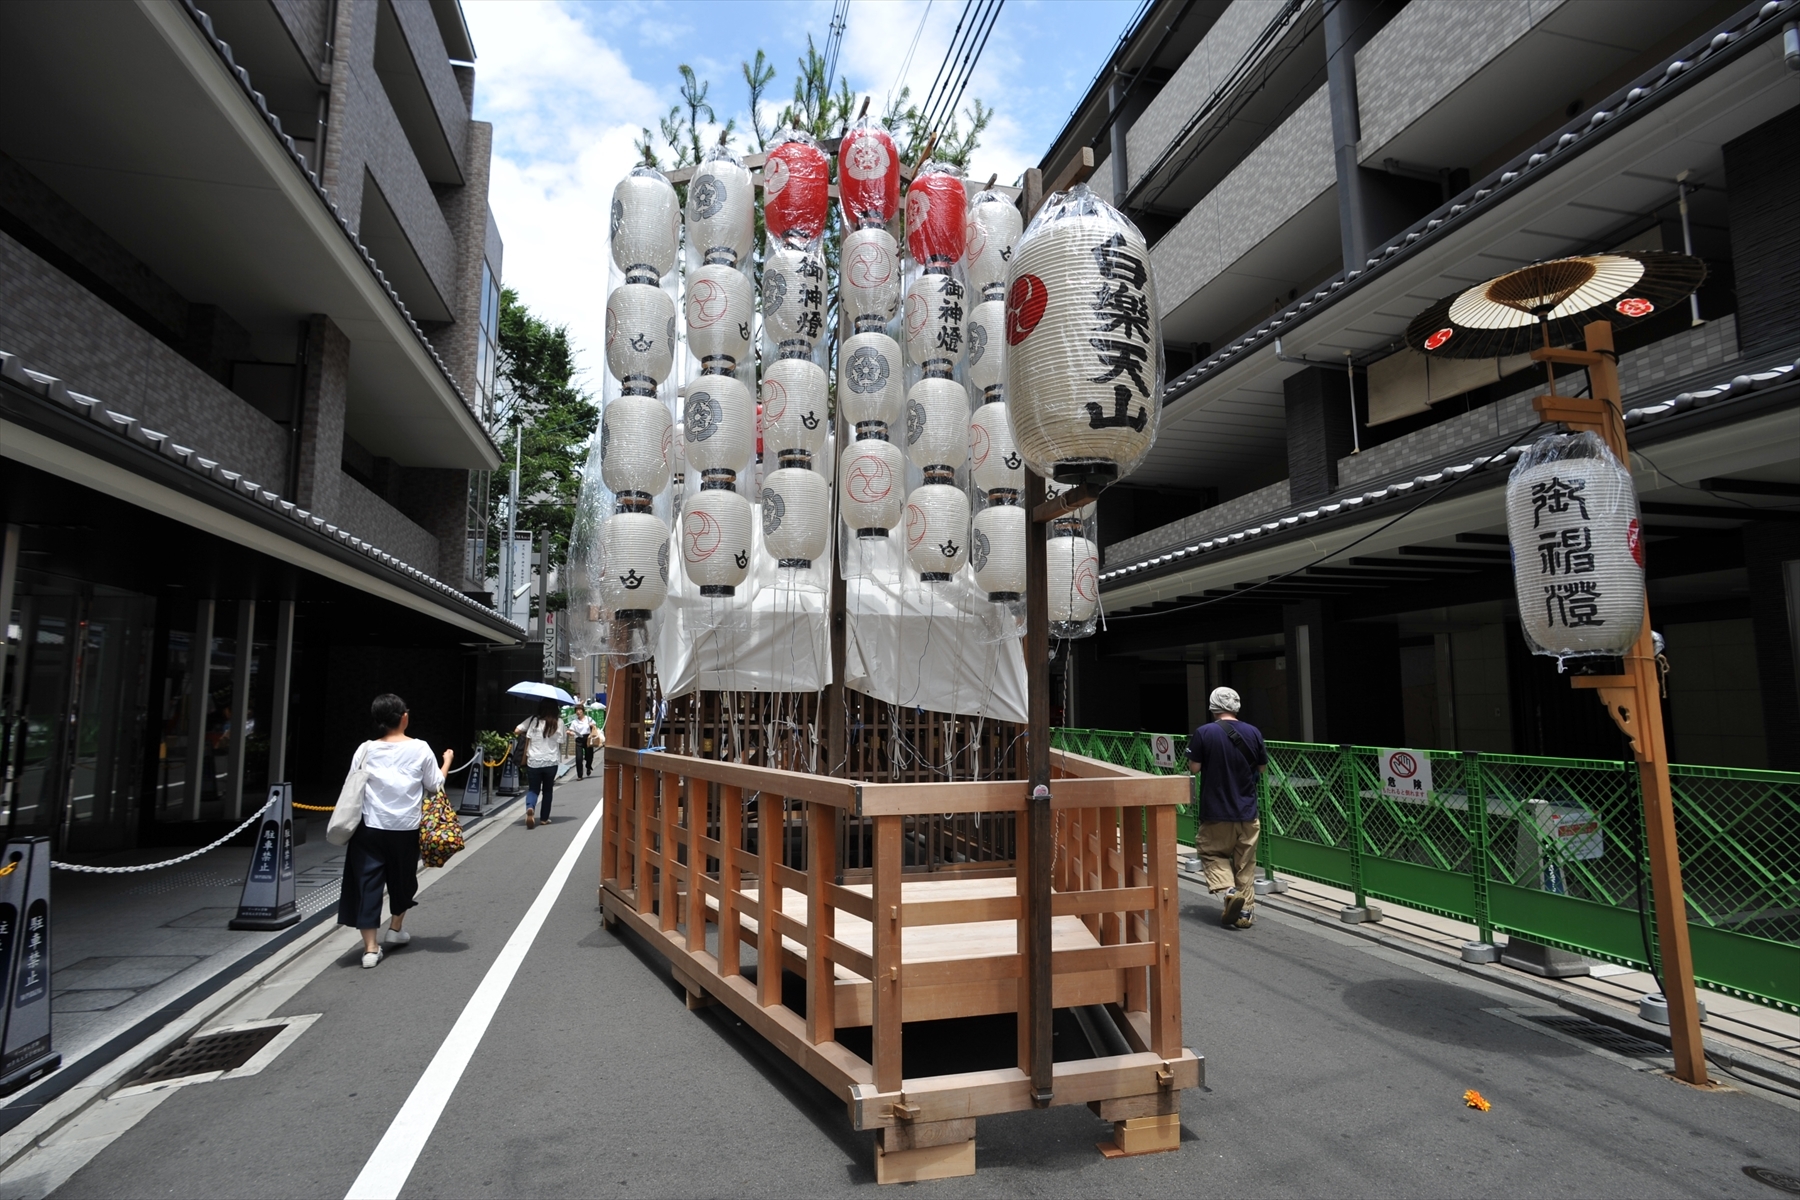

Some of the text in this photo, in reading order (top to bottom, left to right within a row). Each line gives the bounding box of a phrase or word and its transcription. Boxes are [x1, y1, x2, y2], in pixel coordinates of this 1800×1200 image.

[796, 256, 823, 339] 御神燈
[936, 276, 964, 353] 御神燈
[545, 628, 554, 675] ロマンス小杉
[258, 829, 275, 872] 駐車禁止
[25, 914, 44, 987] 駐車禁止
